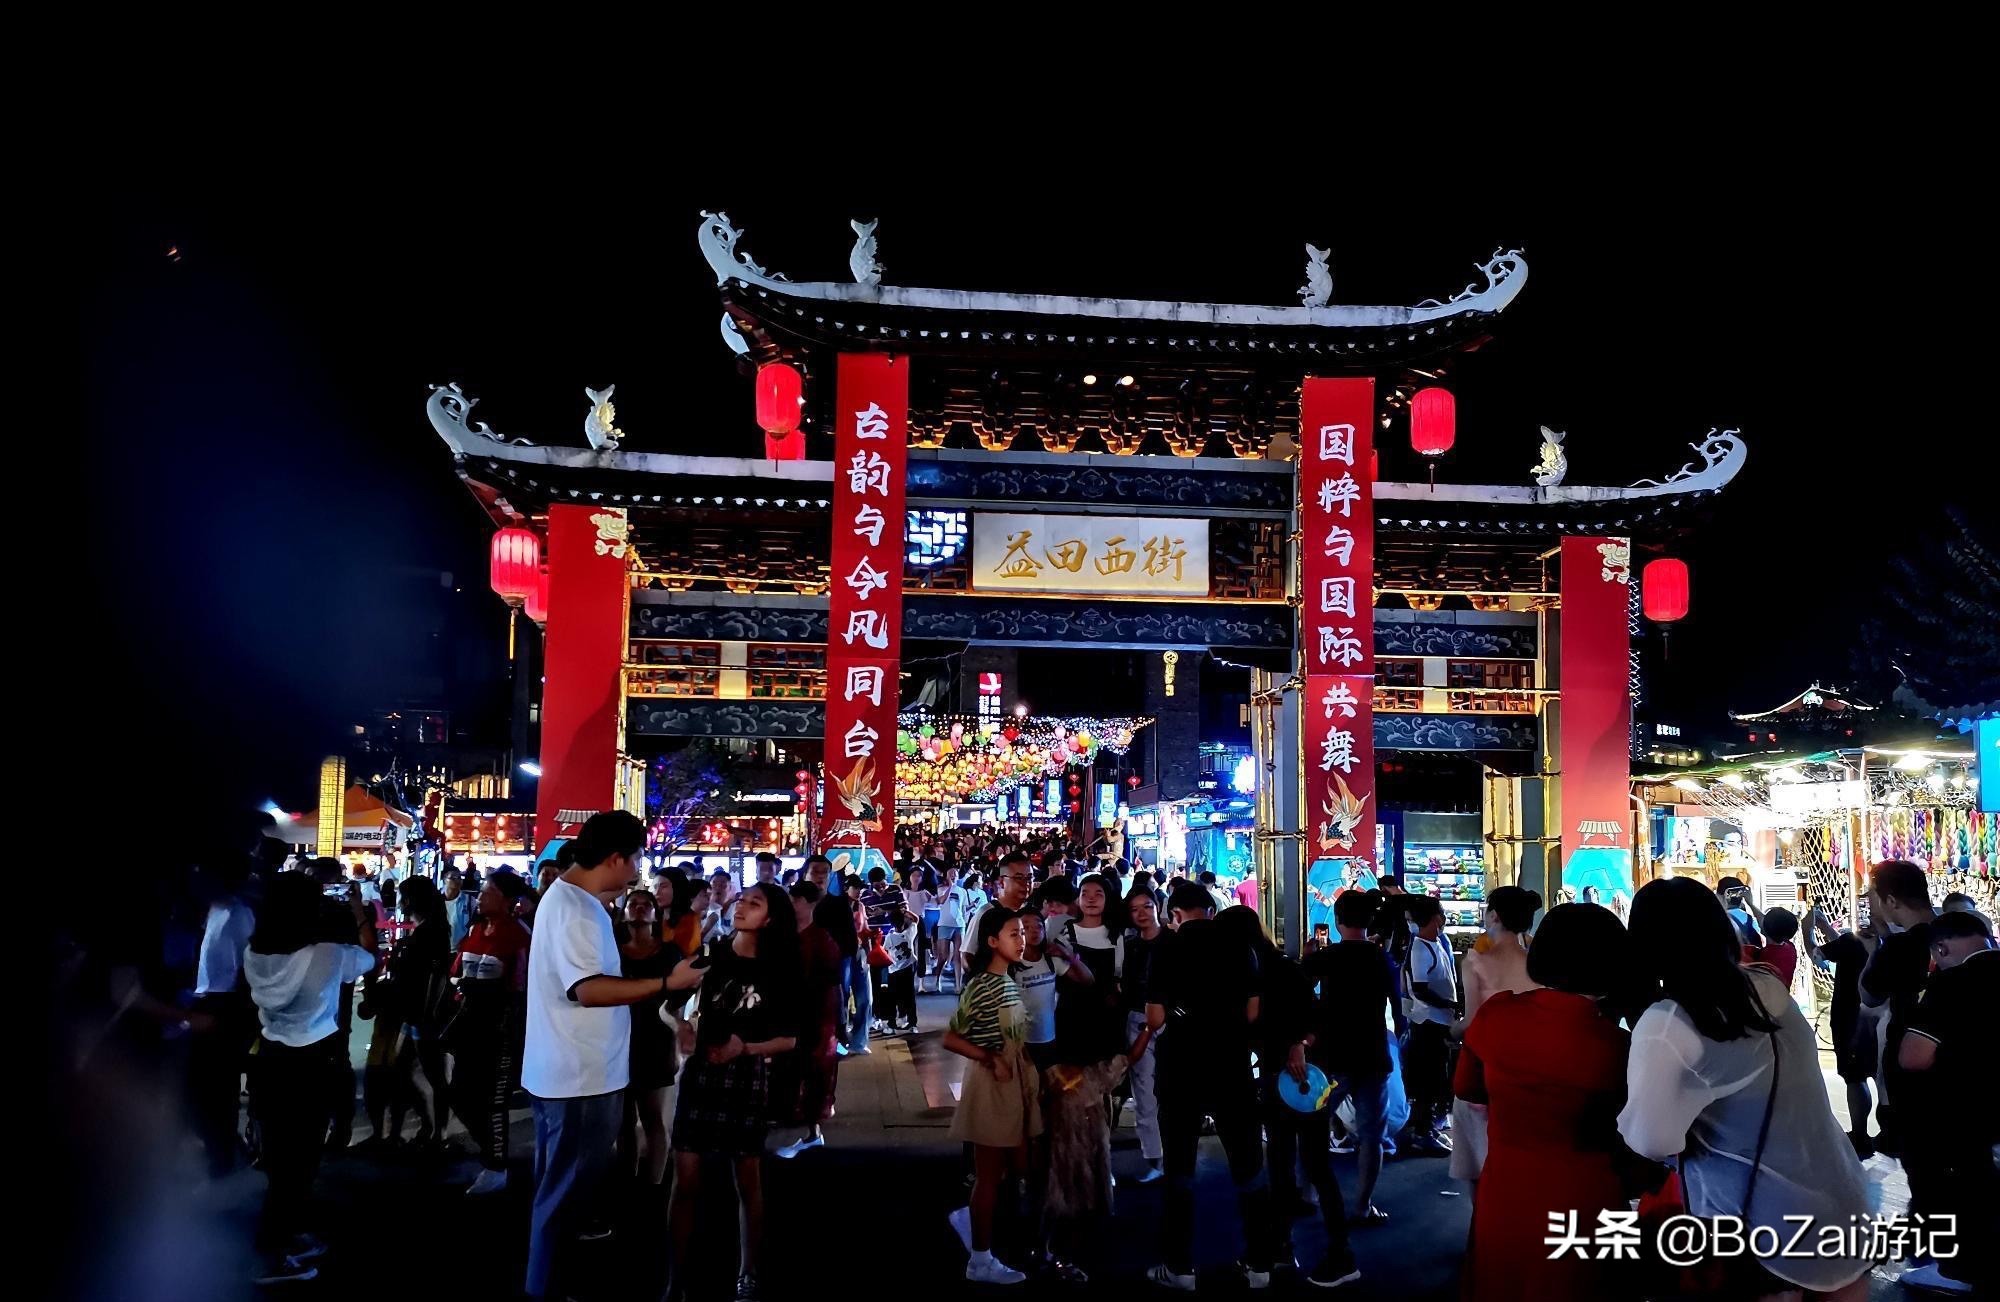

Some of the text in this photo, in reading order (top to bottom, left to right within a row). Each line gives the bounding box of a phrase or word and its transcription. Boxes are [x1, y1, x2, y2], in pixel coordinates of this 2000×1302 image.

[841, 402, 891, 758] 古韵与今风同台
[993, 529, 1188, 581] 益田西街
[1317, 424, 1364, 774] 国粹与国际共舞
